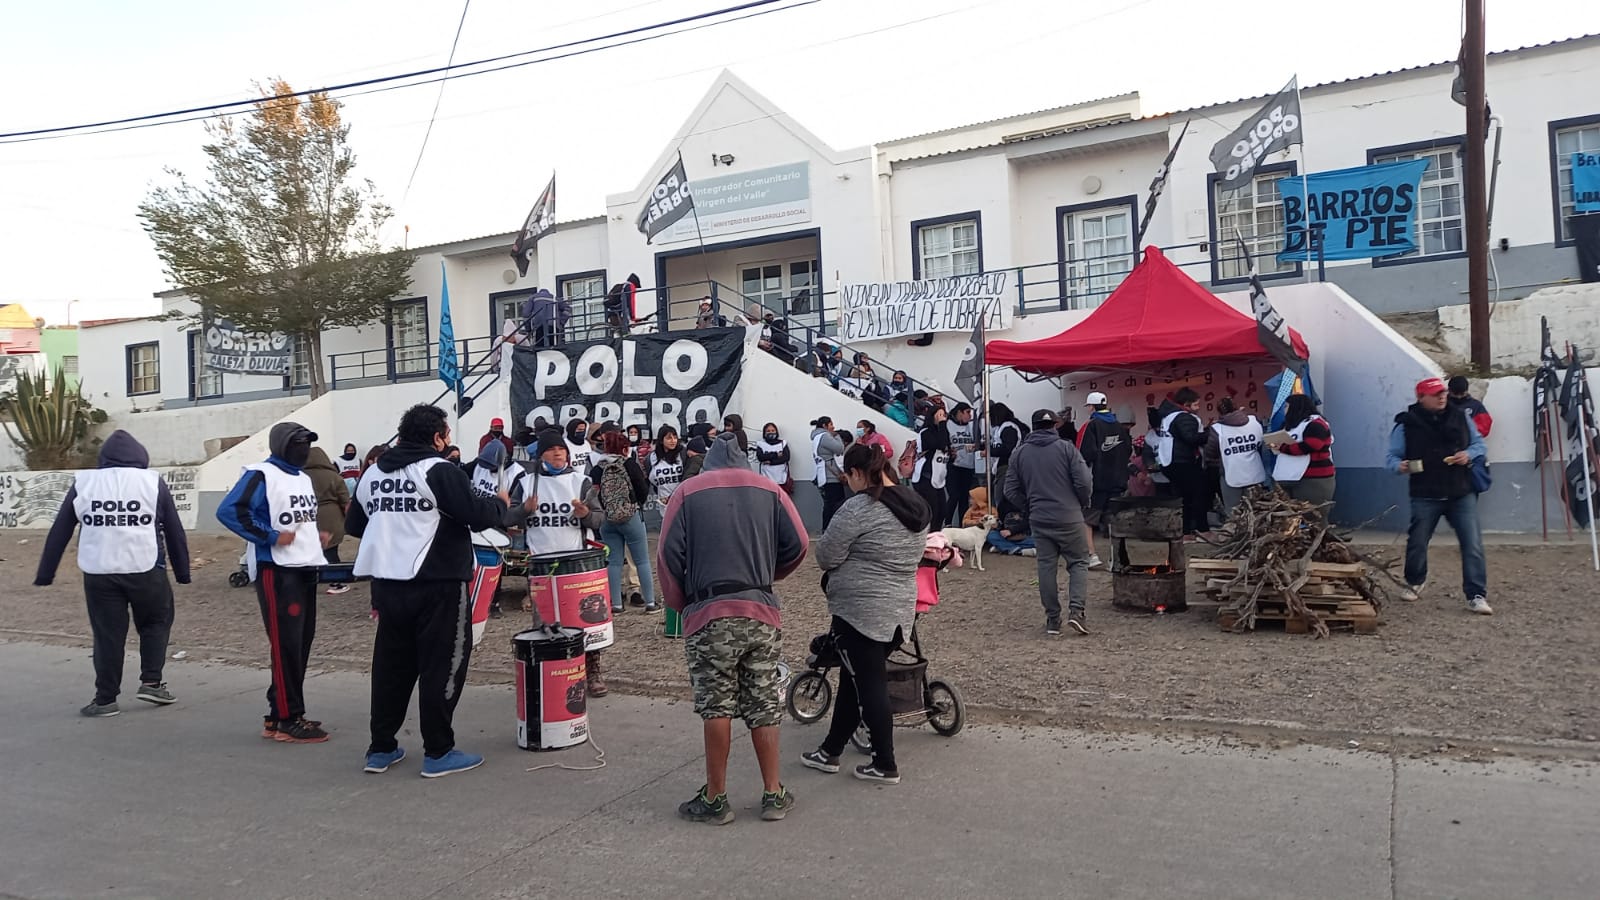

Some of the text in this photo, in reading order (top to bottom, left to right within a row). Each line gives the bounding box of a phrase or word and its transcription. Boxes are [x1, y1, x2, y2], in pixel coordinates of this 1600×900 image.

[694, 171, 801, 197] Integrador Comunitario
[728, 195, 741, 203] del
[1283, 183, 1414, 225] BARRIOS
[1346, 215, 1408, 249] PIE
[877, 302, 917, 337] LINEA
[919, 299, 942, 331] DE
[209, 353, 245, 371] CALETA
[534, 339, 709, 400] POLO
[1228, 433, 1257, 446] POLO
[655, 466, 682, 477] POLO
[370, 478, 417, 496] POLO
[91, 499, 141, 513] POLO
[82, 513, 153, 527] OBRERO
